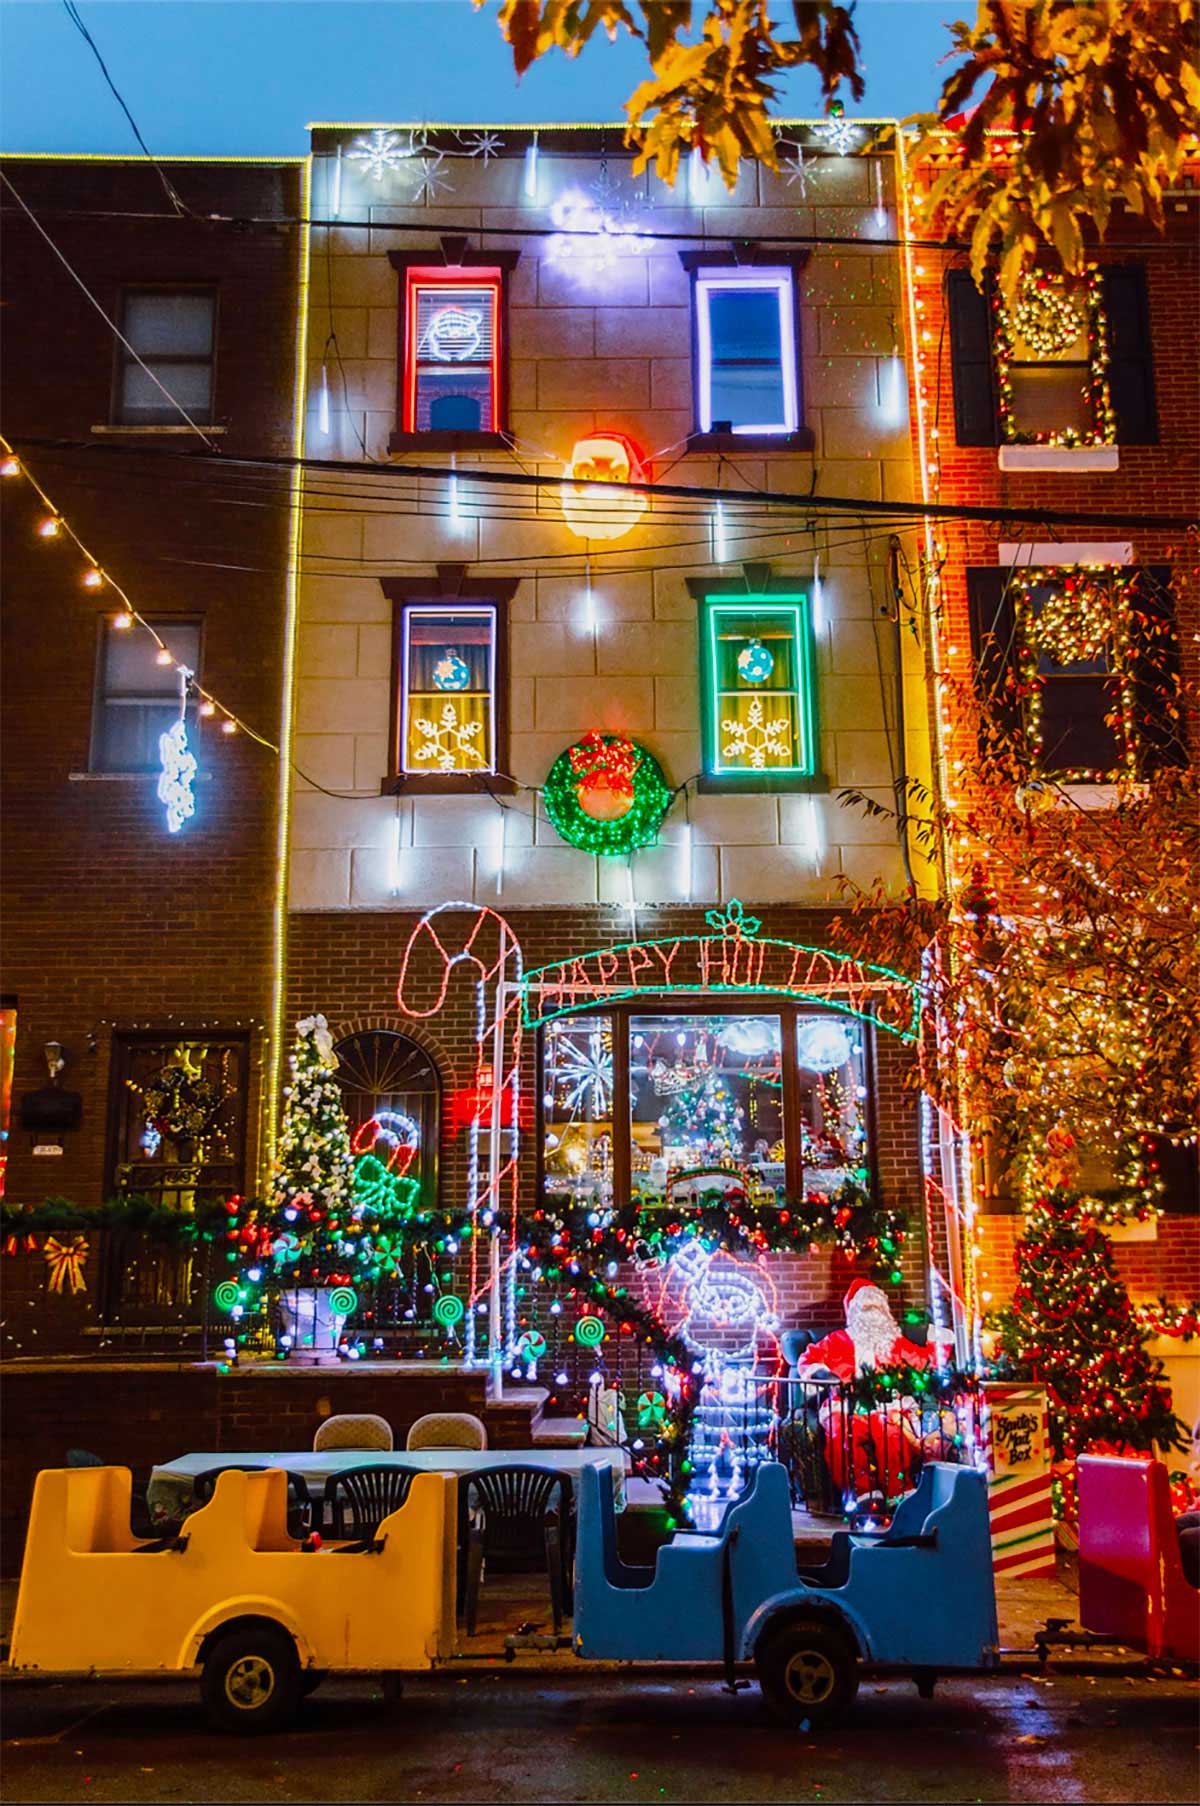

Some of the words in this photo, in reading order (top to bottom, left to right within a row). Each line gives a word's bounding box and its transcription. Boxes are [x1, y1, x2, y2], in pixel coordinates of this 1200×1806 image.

[538, 941, 681, 1019] HAPPY
[996, 1413, 1038, 1442] Santa's
[1006, 1430, 1031, 1448] Mail
[1009, 1447, 1032, 1465] Box
